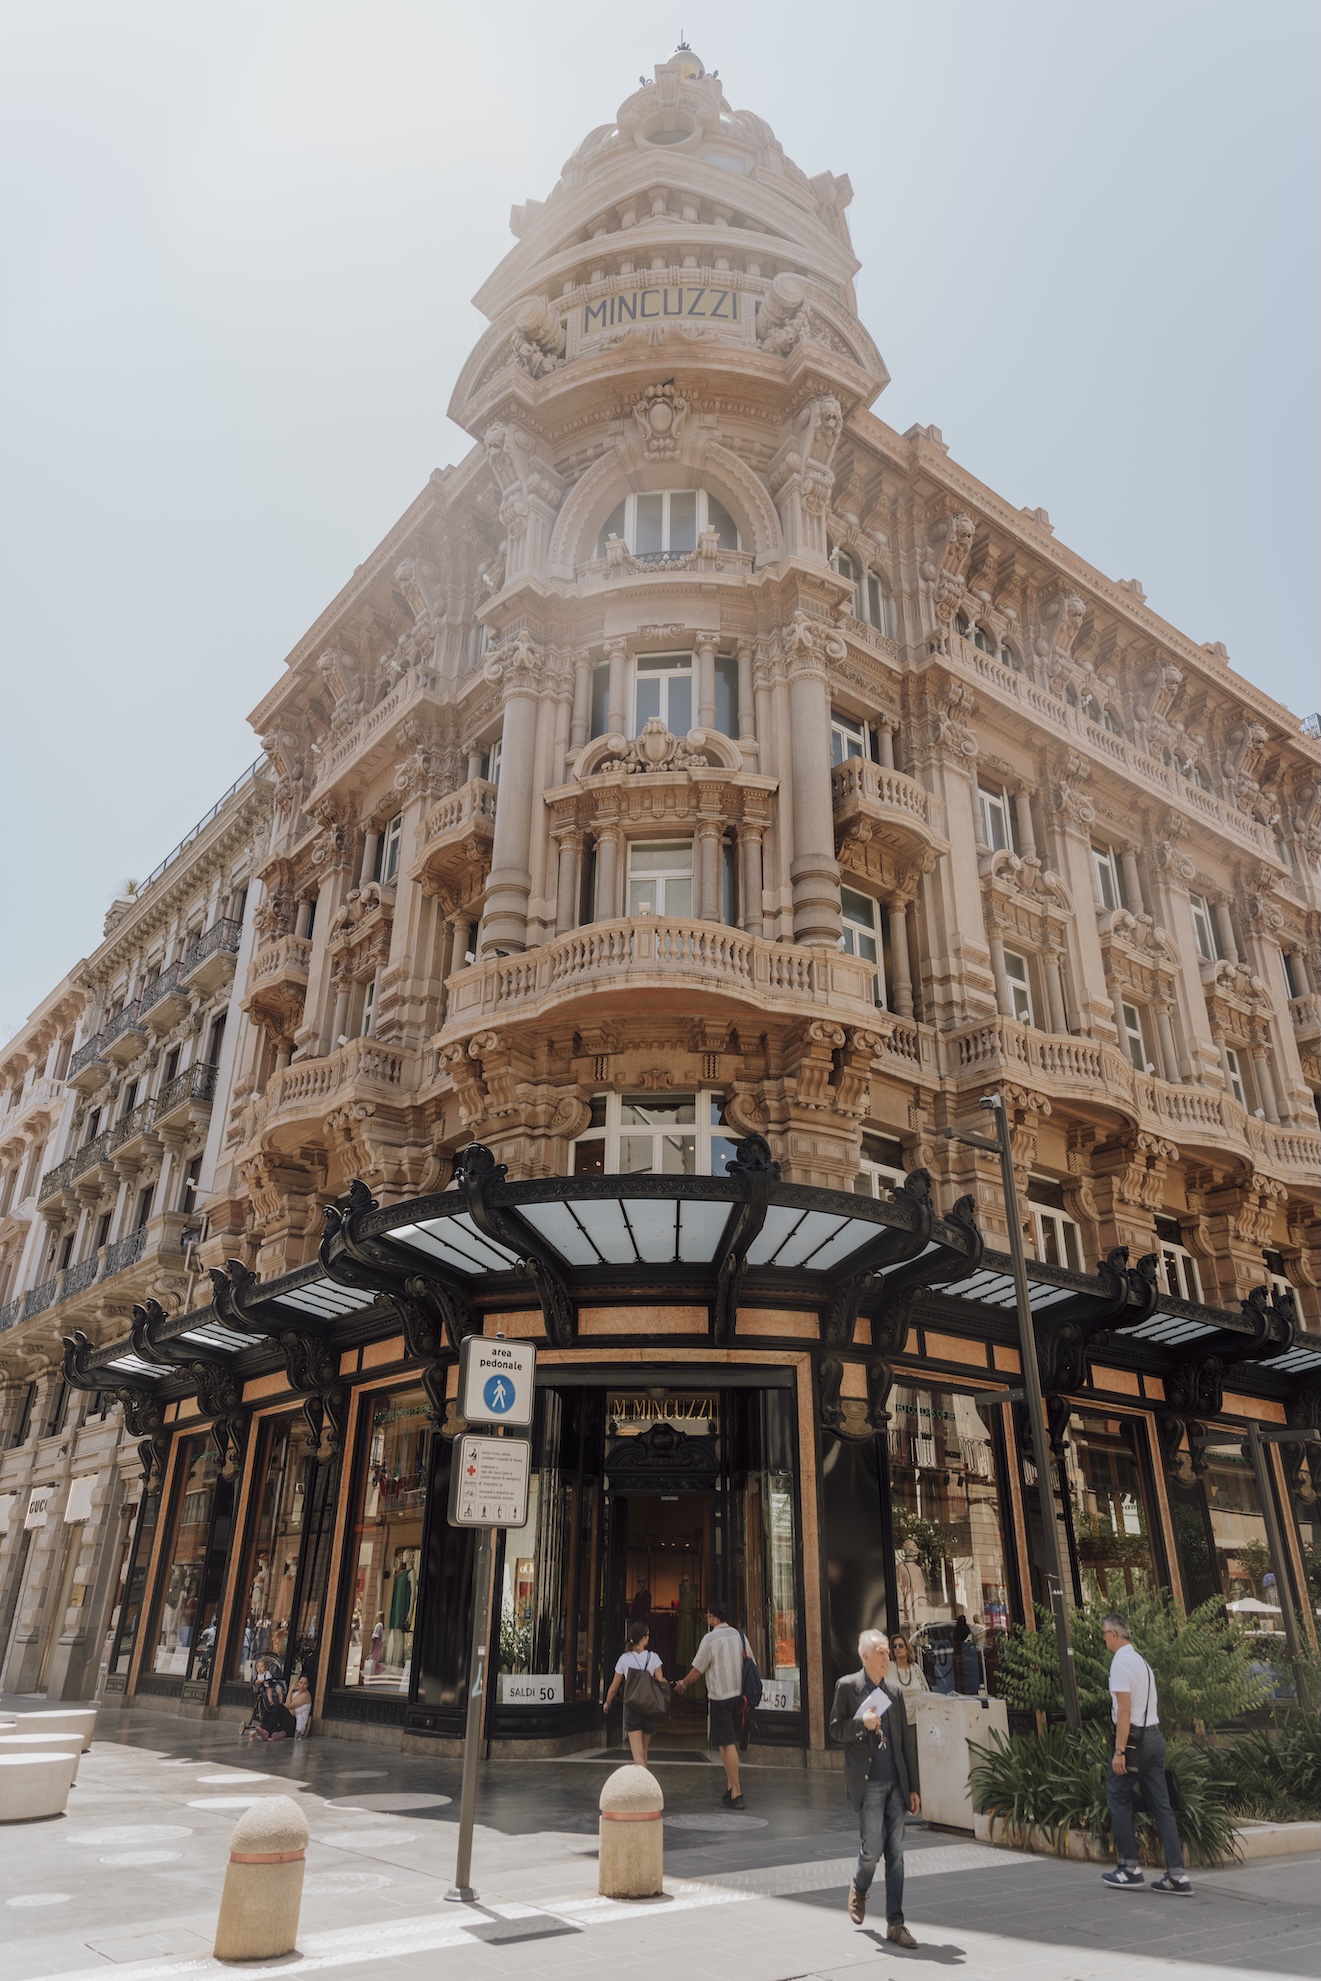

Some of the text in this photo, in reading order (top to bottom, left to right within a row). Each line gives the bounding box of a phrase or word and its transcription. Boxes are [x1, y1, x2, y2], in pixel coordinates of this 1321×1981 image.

[584, 287, 737, 334] MINCUZZI
[491, 1348, 512, 1358] area
[480, 1358, 523, 1371] pedonale
[634, 1399, 713, 1420] MINCUZZI
[510, 1687, 535, 1697] SALDI
